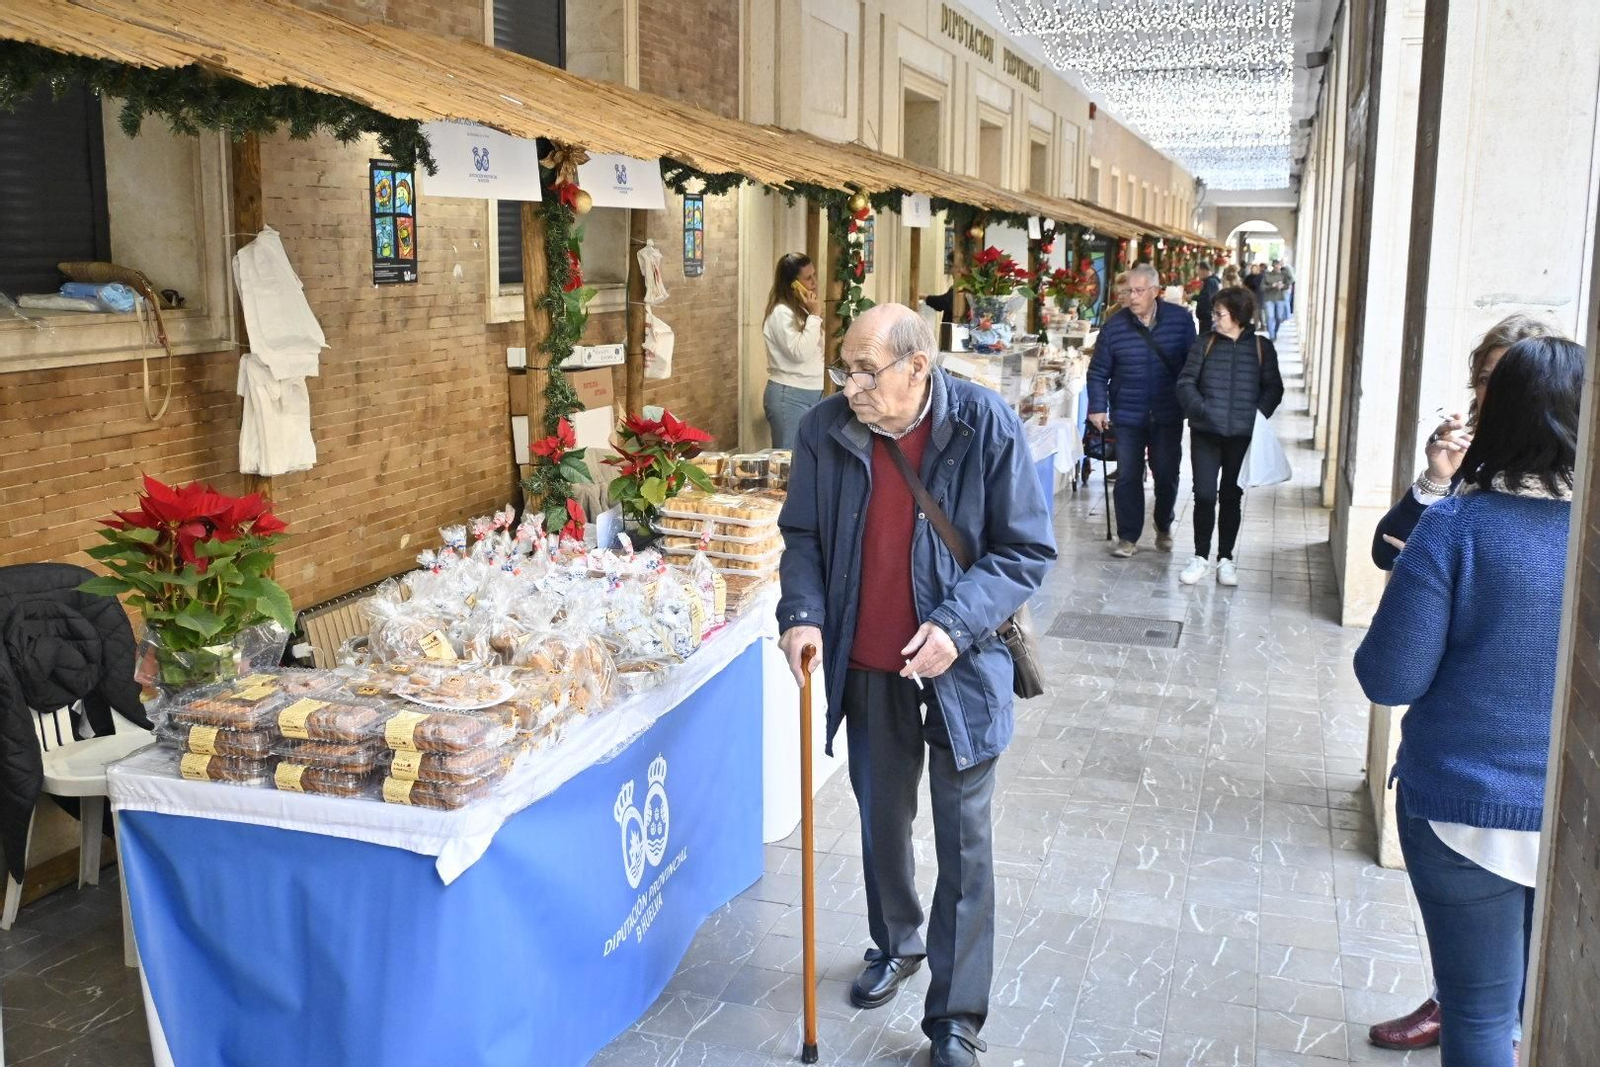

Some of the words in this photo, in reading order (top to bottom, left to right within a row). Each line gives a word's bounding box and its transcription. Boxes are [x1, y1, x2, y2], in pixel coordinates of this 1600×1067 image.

[941, 3, 994, 64] DIPUTACION
[1003, 46, 1040, 93] PROVINCIAL
[603, 892, 648, 957] DIPUTACIÓN
[649, 845, 687, 901] PROVINCIAL
[641, 892, 663, 935] HUELVA
